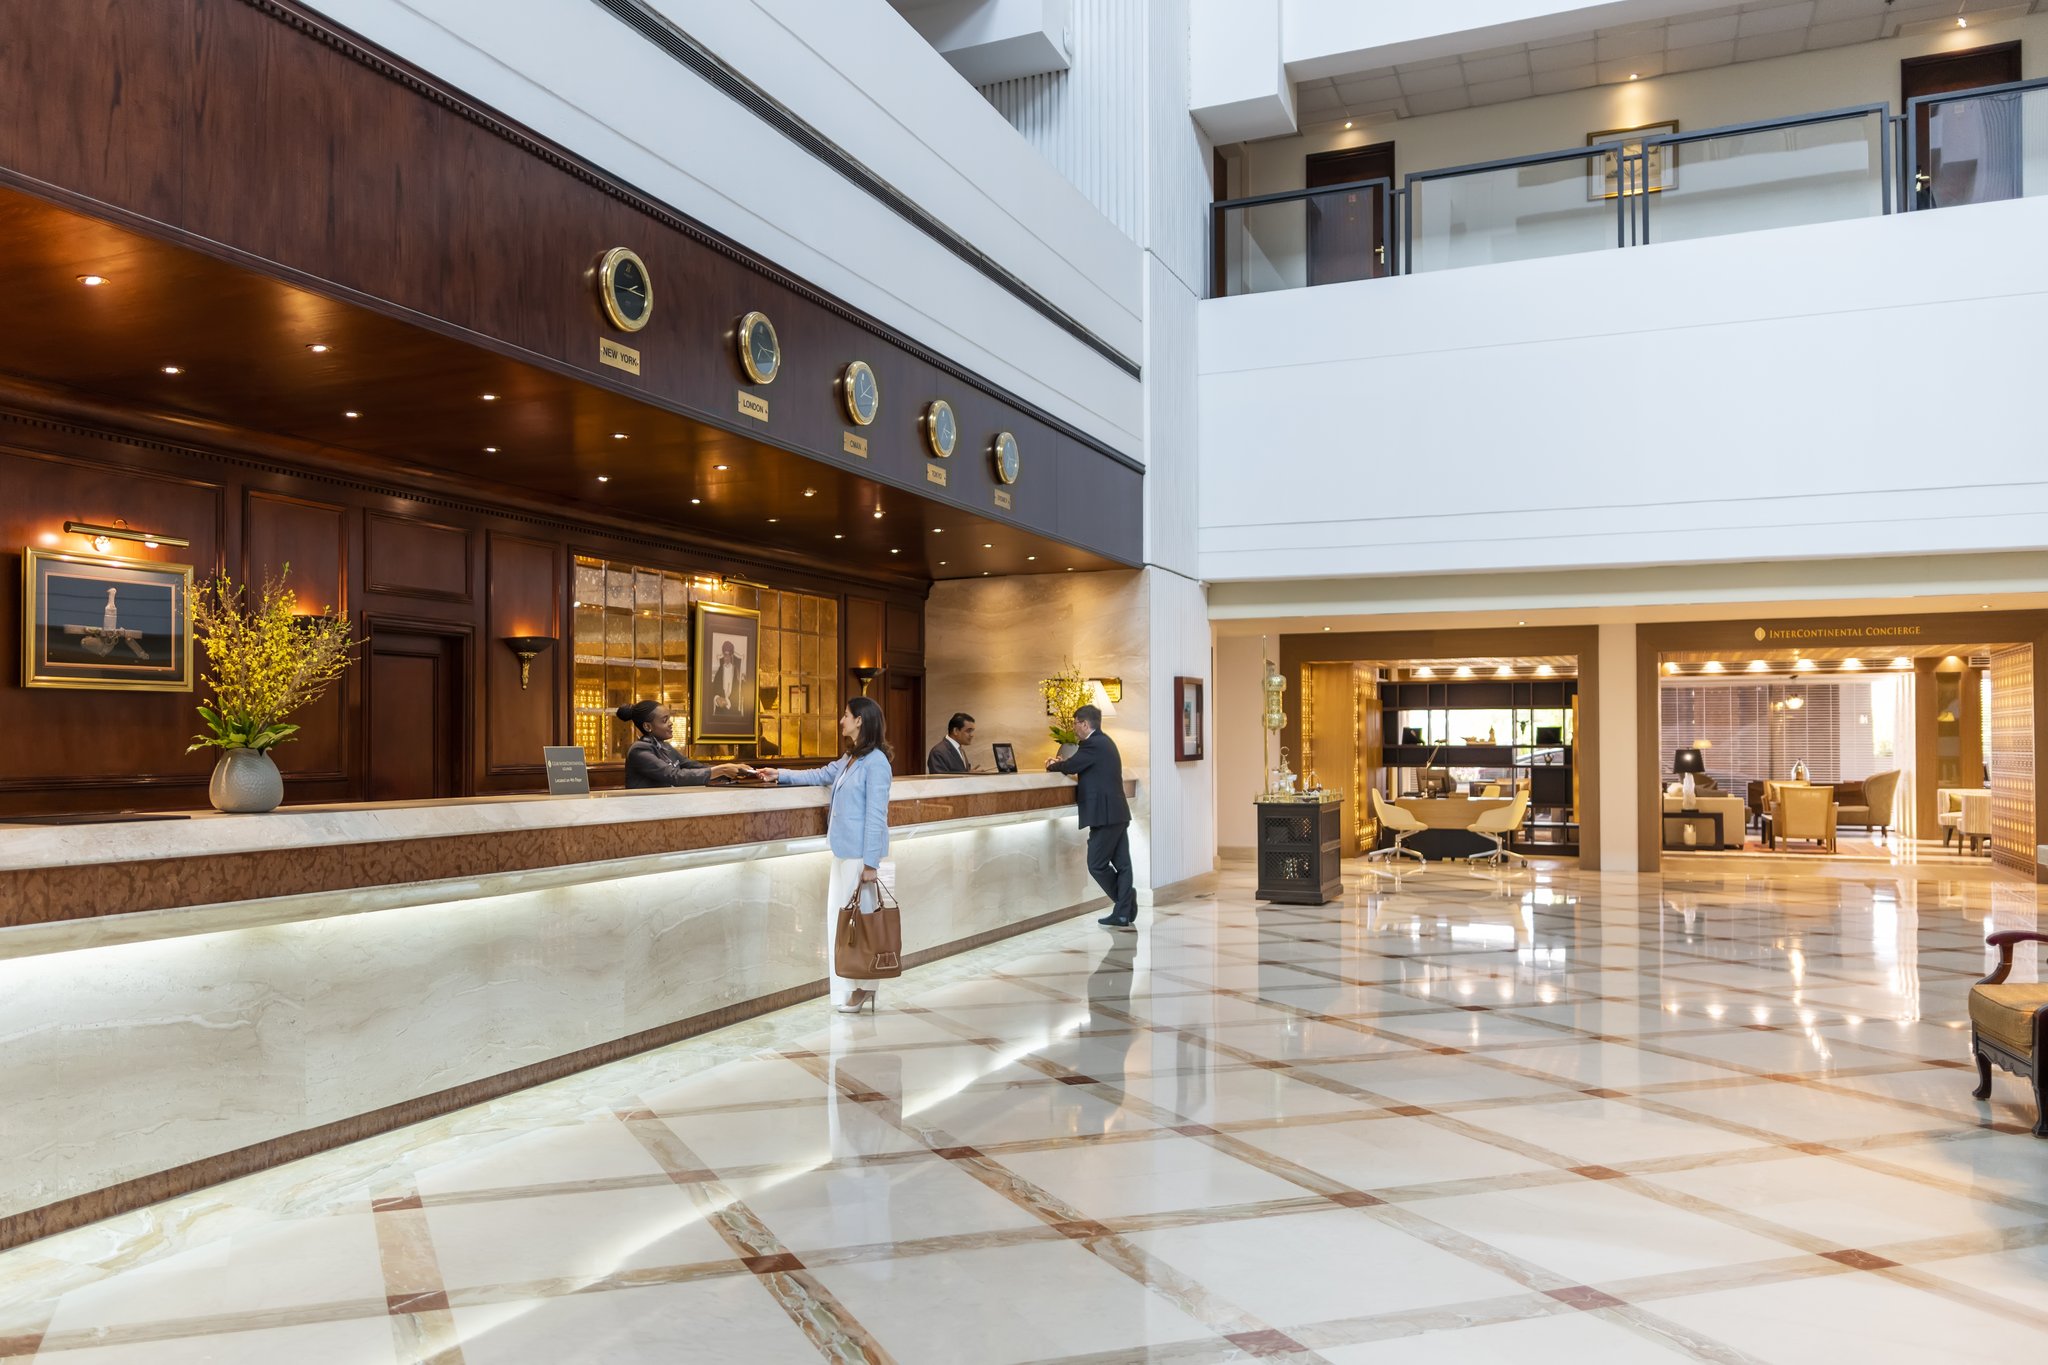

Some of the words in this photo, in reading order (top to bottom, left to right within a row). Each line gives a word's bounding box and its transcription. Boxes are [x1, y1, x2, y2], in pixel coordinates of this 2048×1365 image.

[602, 346, 618, 359] NEW
[620, 353, 637, 366] YORK
[743, 400, 764, 413] LONDON
[1769, 628, 1862, 639] INTERCONTINENTAL
[1865, 626, 1921, 636] CONCIERGE
